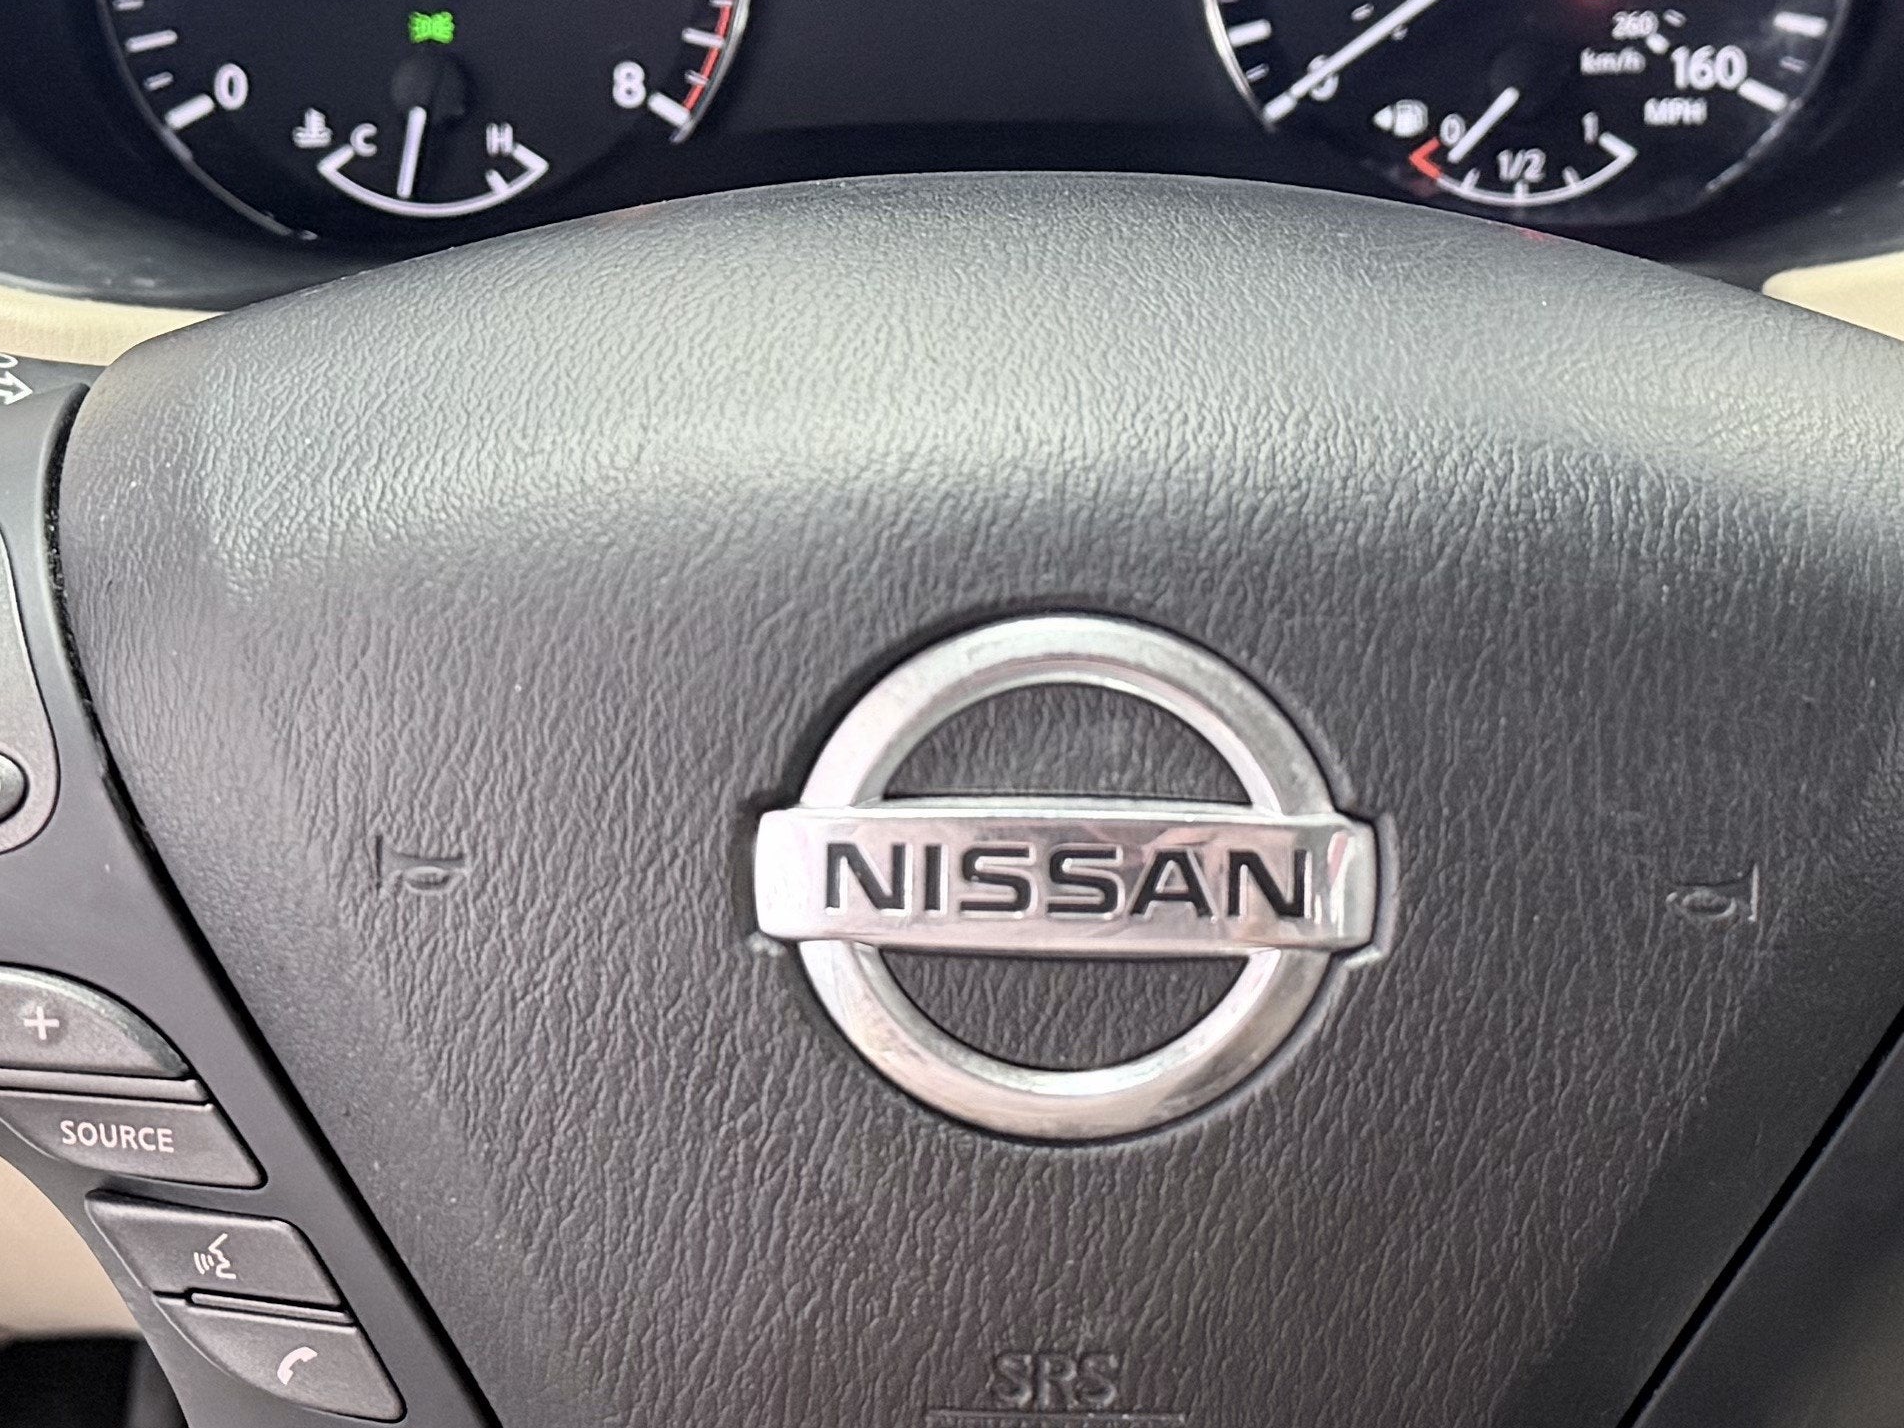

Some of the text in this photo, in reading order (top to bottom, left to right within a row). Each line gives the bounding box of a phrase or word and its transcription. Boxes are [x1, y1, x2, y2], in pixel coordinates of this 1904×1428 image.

[1612, 10, 1658, 39] 260
[1580, 48, 1646, 75] km/h
[1670, 44, 1749, 92] 160
[213, 62, 249, 111] 0
[611, 61, 646, 109] 8
[1582, 113, 1599, 143] 1
[1643, 97, 1708, 127] MPH
[350, 124, 378, 155] C
[486, 123, 514, 153] H
[1441, 114, 1467, 147] 0
[1497, 148, 1546, 182] 1/2
[825, 841, 1312, 921] NISSAN
[60, 1119, 175, 1154] SOURCE
[996, 1352, 1118, 1410] SRS
